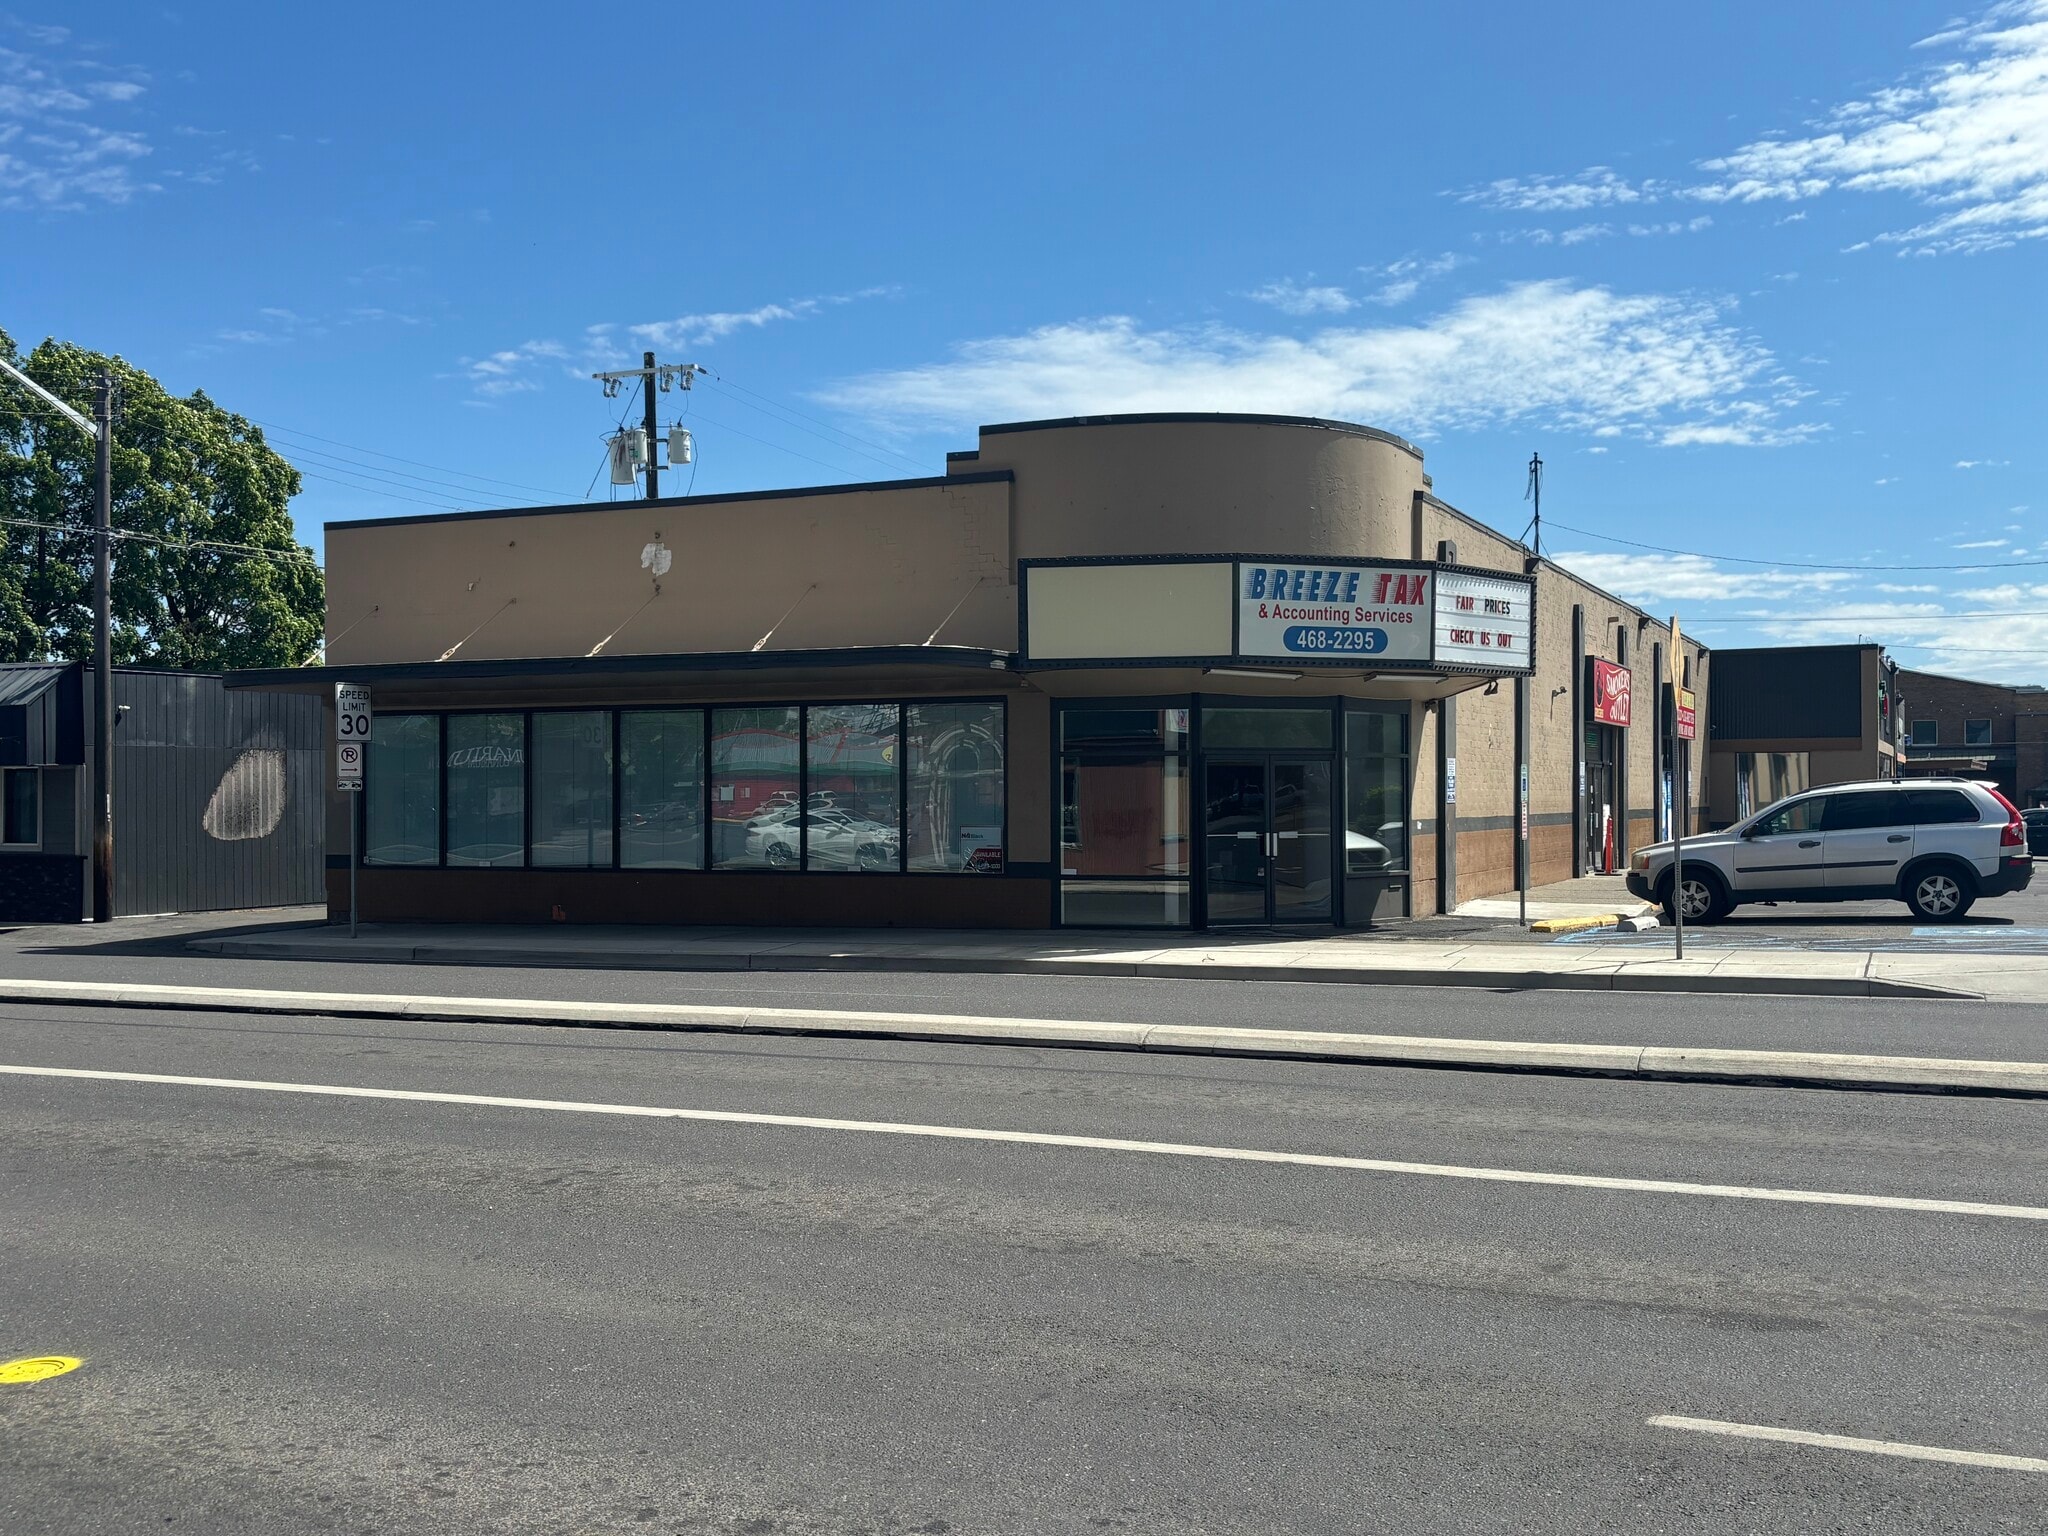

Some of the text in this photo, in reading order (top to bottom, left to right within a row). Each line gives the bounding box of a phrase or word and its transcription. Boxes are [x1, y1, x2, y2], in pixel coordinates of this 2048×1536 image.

[1244, 568, 1428, 605] BREEZE TAX
[1258, 603, 1413, 625] & Accounting Services
[1456, 595, 1511, 615] FAIR PRICES
[1297, 630, 1374, 650] 468-2295
[1450, 629, 1513, 648] CHECK US OUT
[339, 690, 370, 700] SPEED
[343, 702, 367, 712] LIMIT
[1610, 693, 1630, 722] OUTLET
[341, 714, 369, 735] 30
